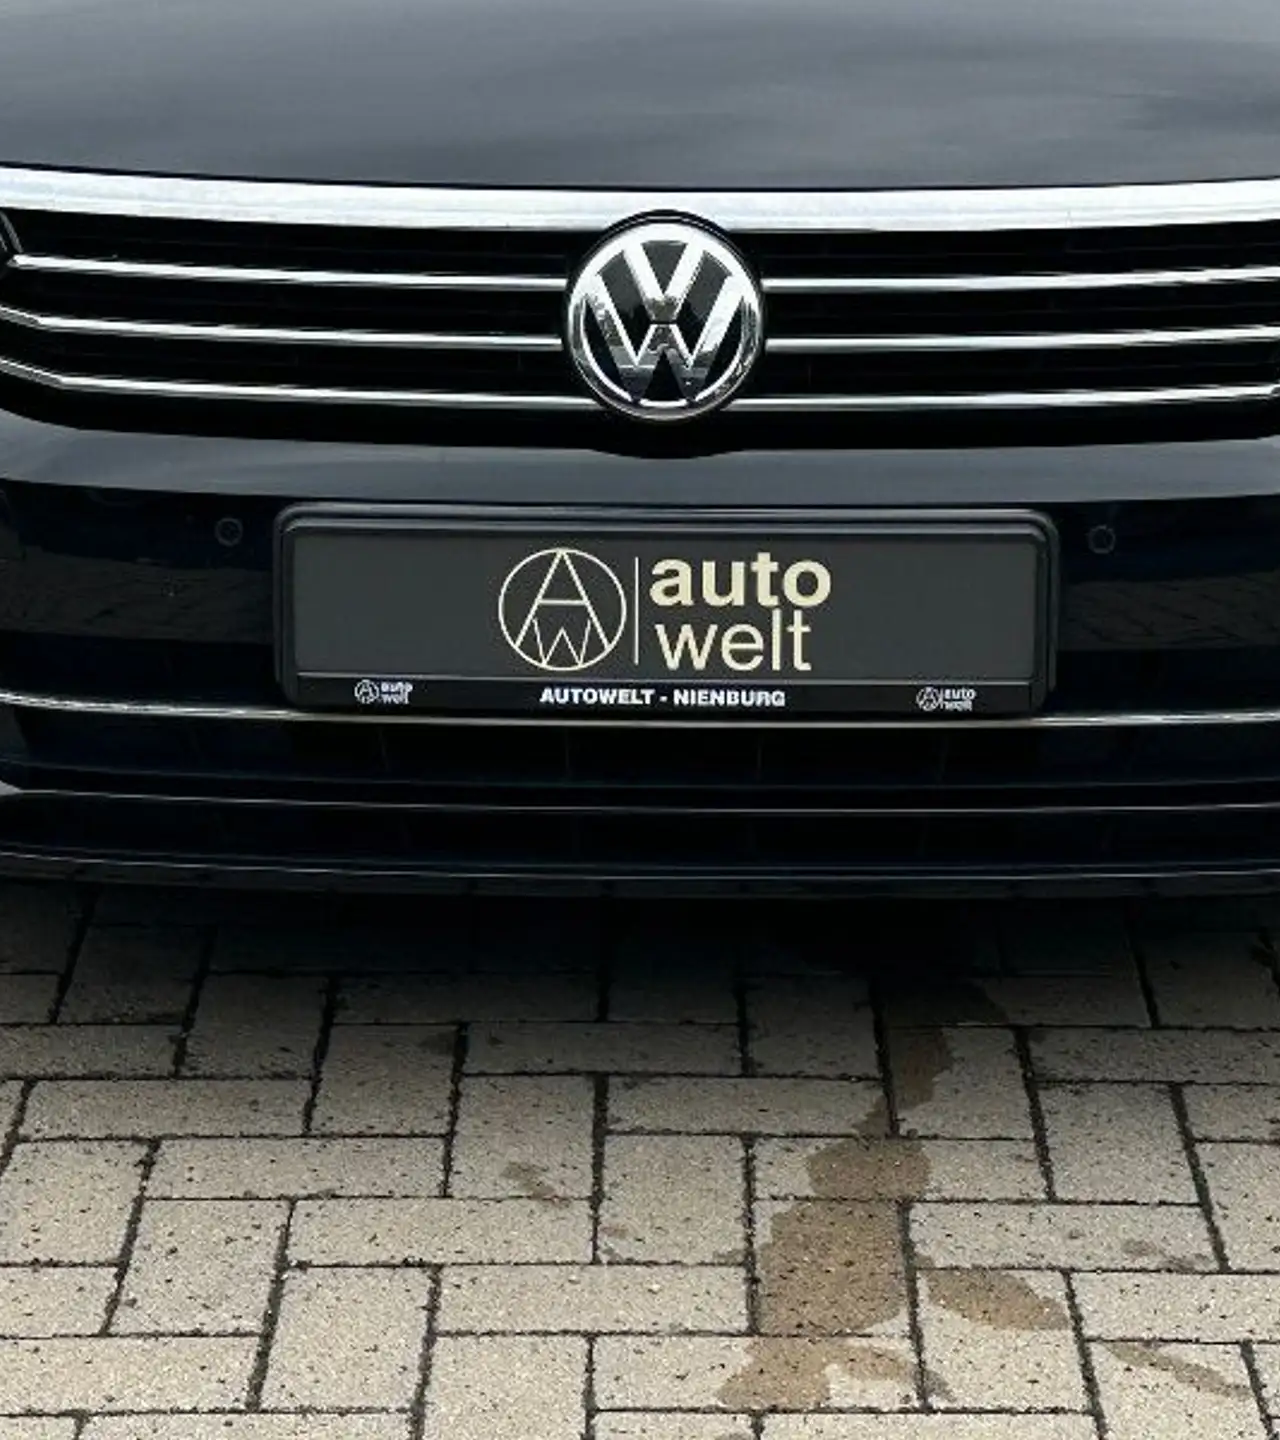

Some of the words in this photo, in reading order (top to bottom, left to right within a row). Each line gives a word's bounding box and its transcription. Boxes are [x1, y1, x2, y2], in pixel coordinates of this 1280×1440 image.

[649, 552, 831, 608] auto
[654, 608, 812, 672] welt
[539, 687, 656, 706] AUTOWELT
[673, 688, 786, 707] NIENBURG
